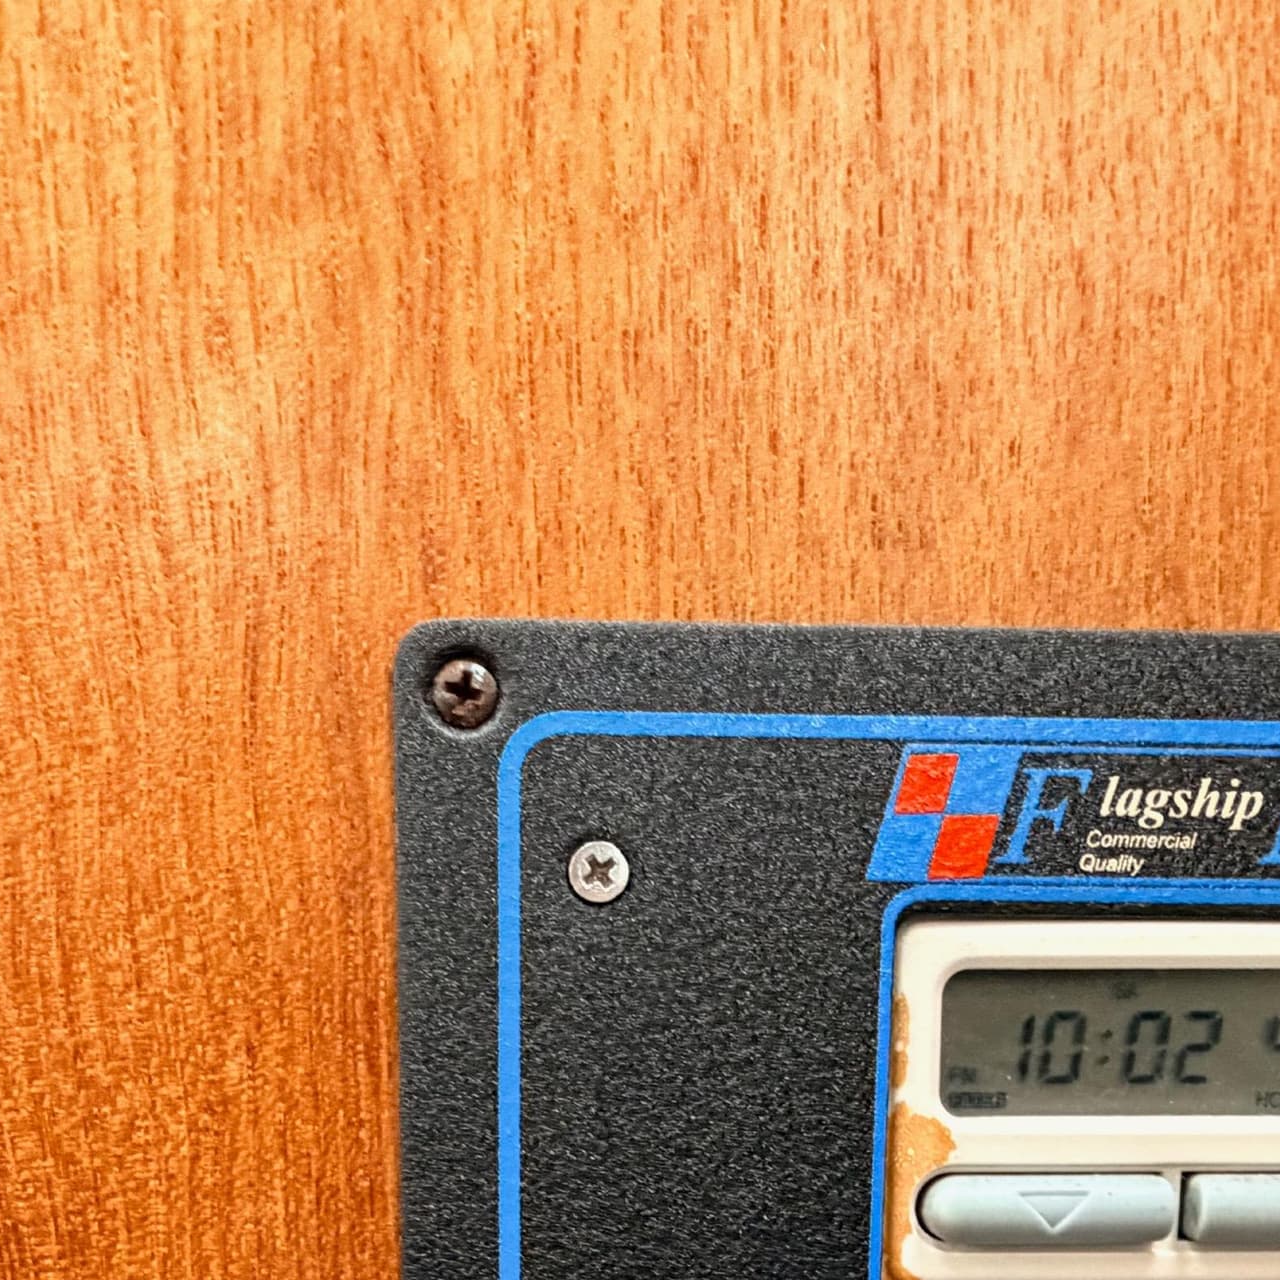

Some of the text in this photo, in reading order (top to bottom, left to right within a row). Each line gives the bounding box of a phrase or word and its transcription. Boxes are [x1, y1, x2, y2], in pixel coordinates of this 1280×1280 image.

[994, 767, 1265, 865] Flagship
[1086, 831, 1197, 850] Commercial
[1079, 854, 1144, 876] Quality
[1017, 1010, 1223, 1084] 10:02
